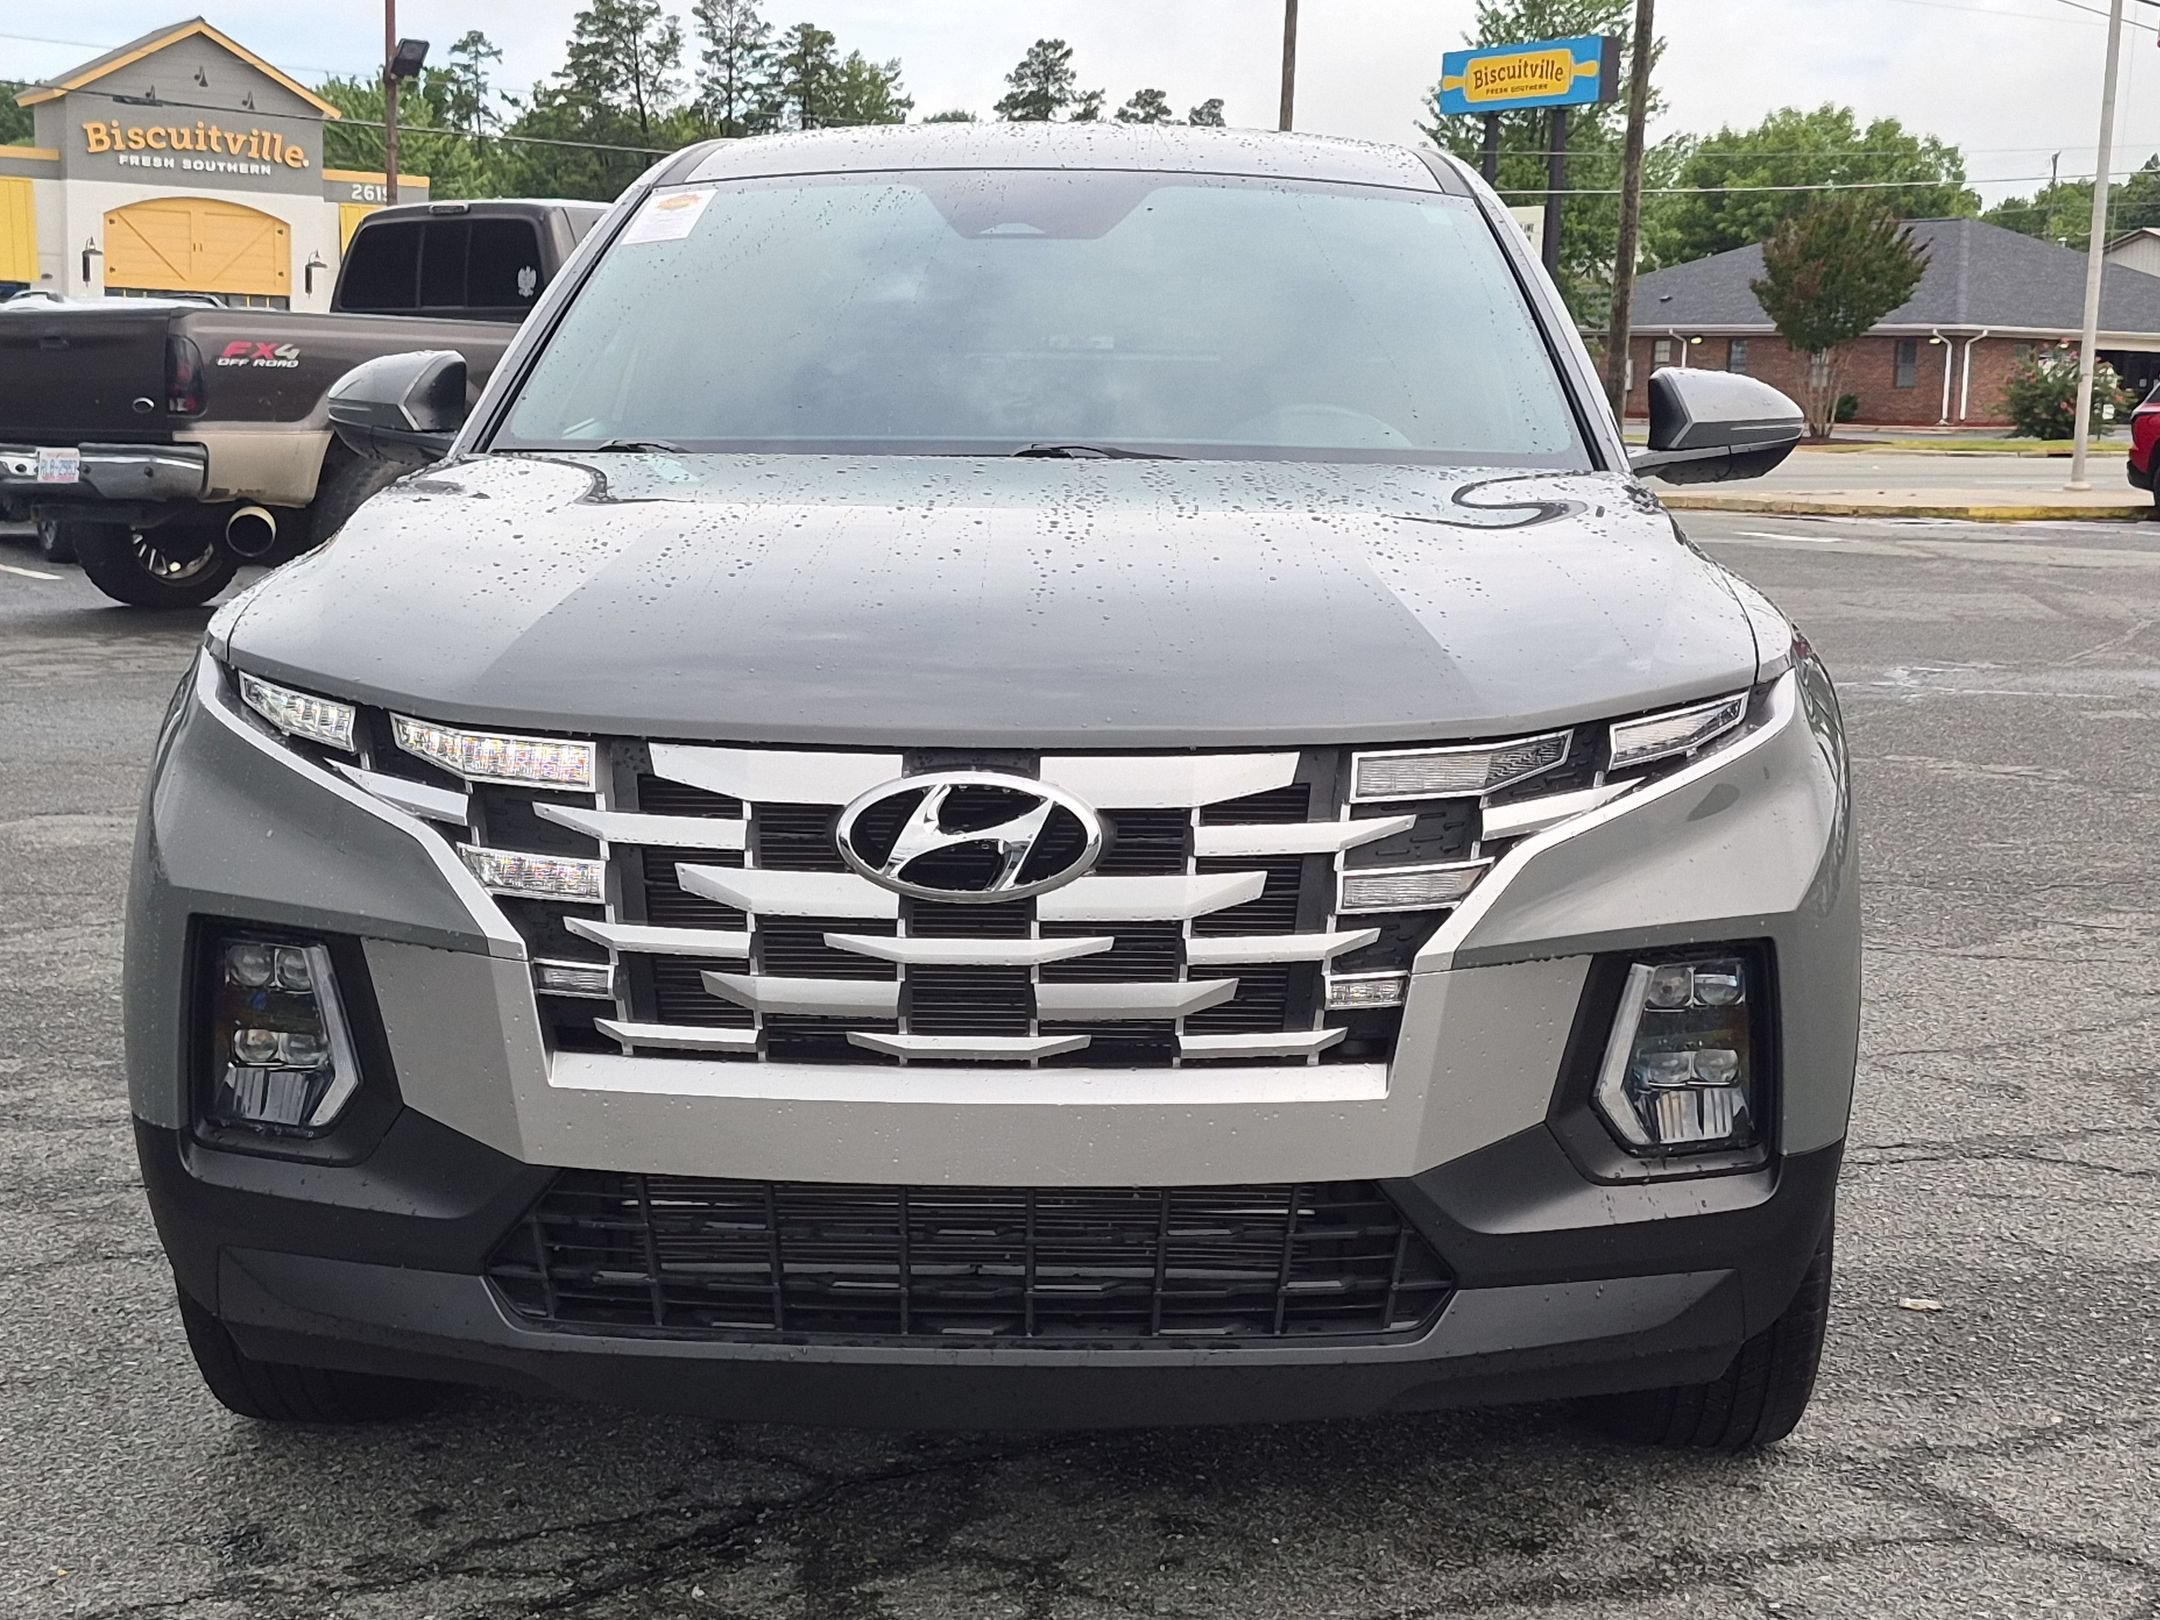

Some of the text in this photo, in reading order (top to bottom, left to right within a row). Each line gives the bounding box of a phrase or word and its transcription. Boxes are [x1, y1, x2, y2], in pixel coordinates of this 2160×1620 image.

[1473, 58, 1564, 90] Biscuitville
[82, 119, 306, 168] Biscuitville
[118, 154, 272, 176] FRESH SOUTHERN
[222, 340, 301, 360] FX4
[216, 357, 300, 369] OFF ROAD
